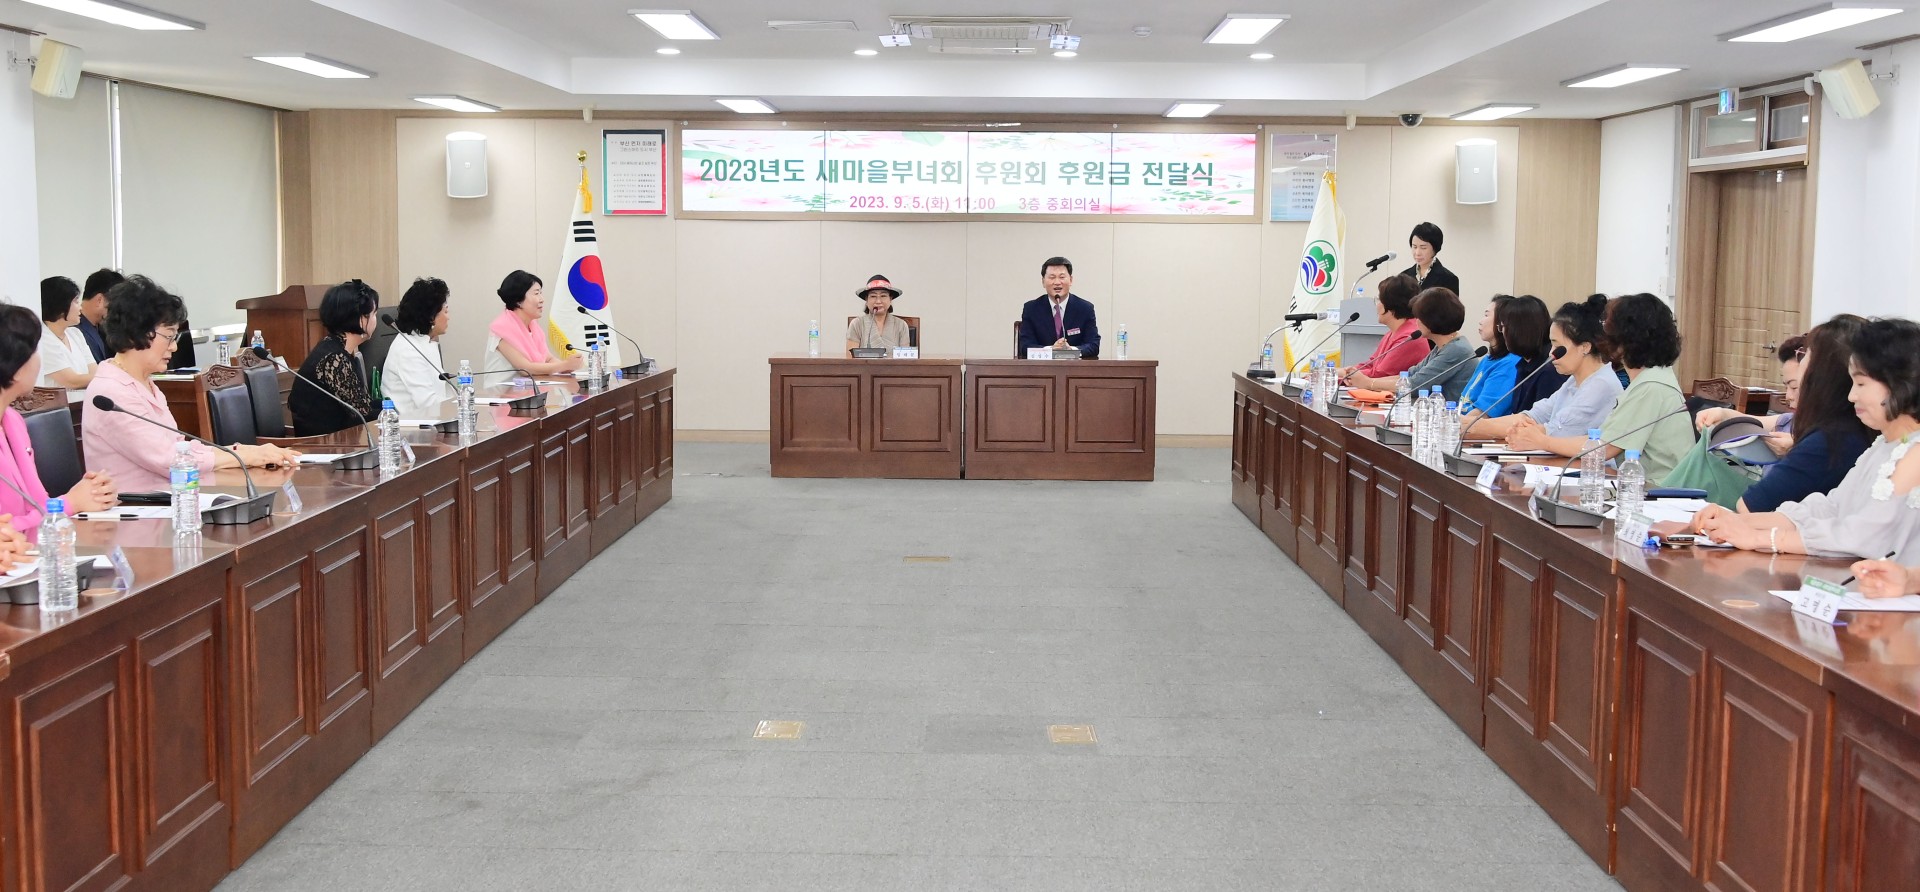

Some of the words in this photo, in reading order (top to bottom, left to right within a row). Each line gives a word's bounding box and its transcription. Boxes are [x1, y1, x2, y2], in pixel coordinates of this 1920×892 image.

[700, 159, 805, 182] 2023년도
[815, 159, 962, 184] 새마을부녀회
[975, 161, 1046, 185] 후원회
[1058, 161, 1131, 186] 후원금
[1142, 161, 1213, 186] 전달식
[849, 196, 889, 208] 2023.
[894, 196, 907, 209] 9.
[954, 196, 996, 211] 11:00
[1018, 197, 1041, 211] 3층
[1046, 197, 1101, 211] 중회의실
